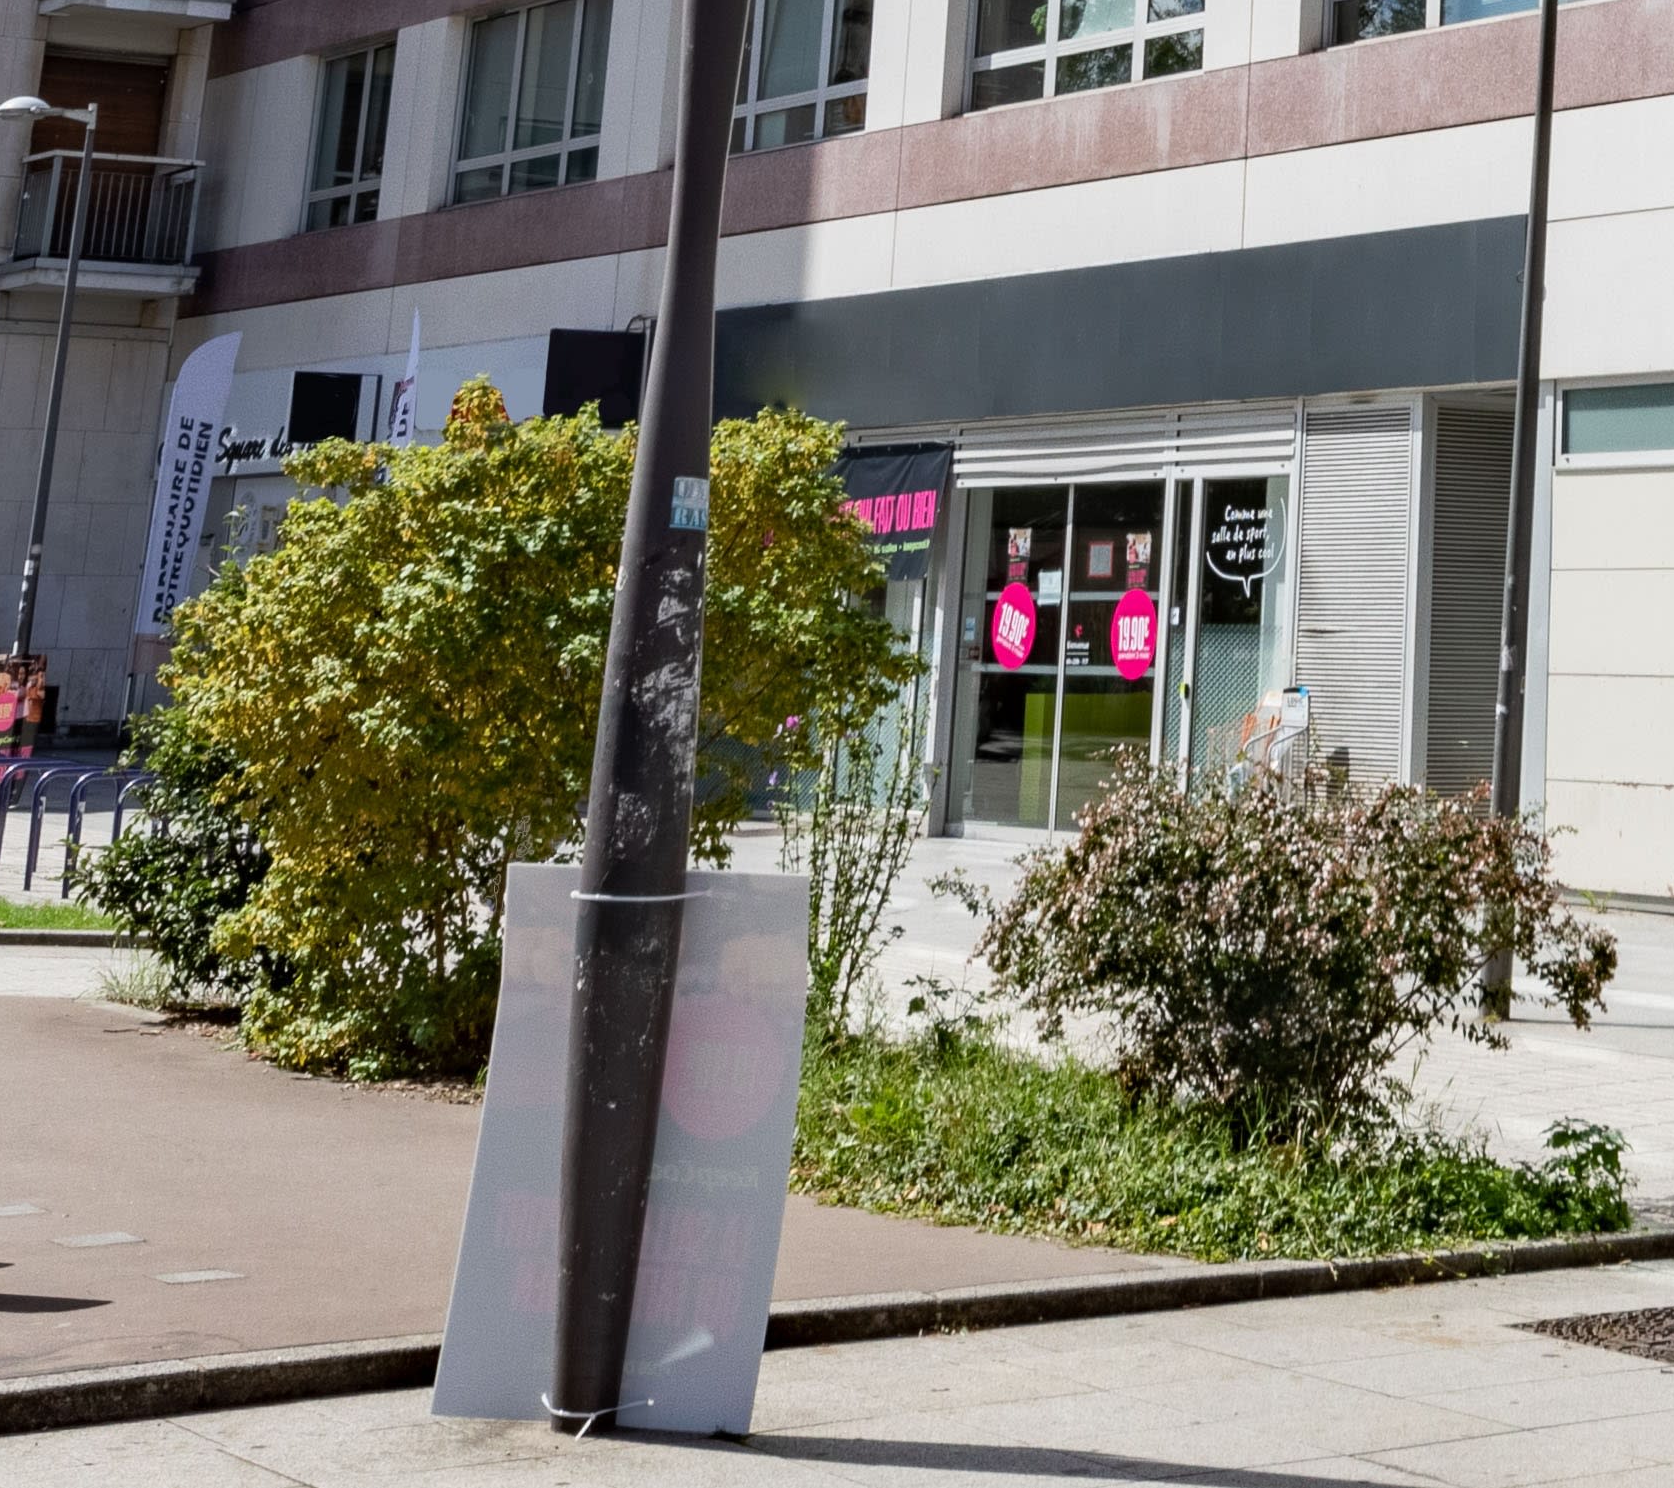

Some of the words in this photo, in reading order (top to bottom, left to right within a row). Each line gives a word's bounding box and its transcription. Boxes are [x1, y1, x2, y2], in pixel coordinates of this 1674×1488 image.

[180, 415, 195, 451] DE
[214, 427, 266, 475] Square
[873, 495, 896, 535] FAIT
[911, 489, 937, 531] BIEN
[1224, 504, 1255, 522] Comme
[1257, 508, 1273, 520] une
[1211, 525, 1231, 544] salle
[1233, 524, 1244, 542] de
[1246, 523, 1270, 544] sport,
[1226, 549, 1237, 561] en
[1238, 542, 1256, 564] plus
[1258, 542, 1275, 560] cool
